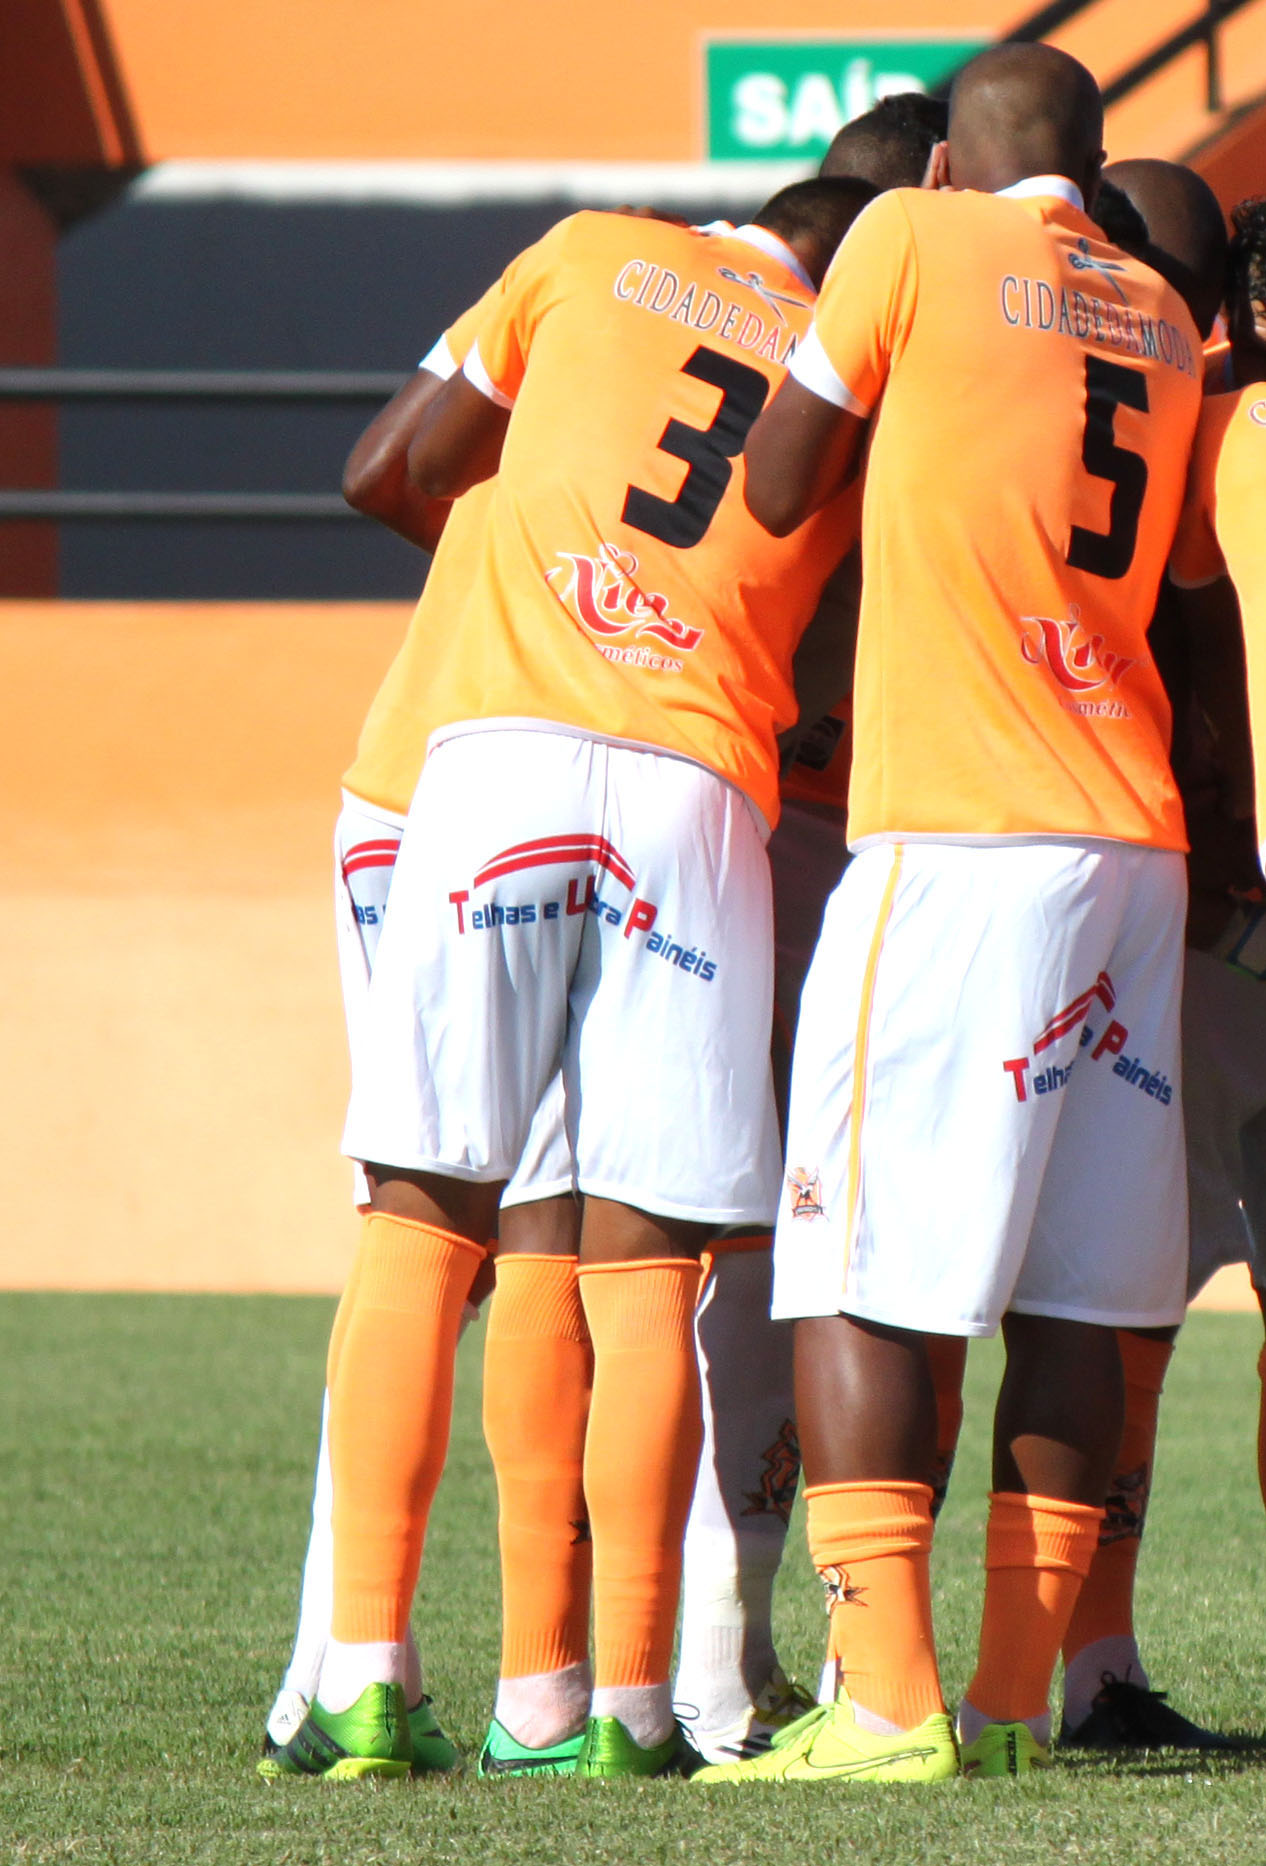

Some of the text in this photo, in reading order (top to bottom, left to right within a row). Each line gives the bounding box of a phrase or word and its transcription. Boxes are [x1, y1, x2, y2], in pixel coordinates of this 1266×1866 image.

[620, 344, 770, 549] 3
[1065, 354, 1149, 579] 5
[449, 889, 537, 935] Telhas
[543, 901, 560, 920] e
[624, 897, 718, 983] Painéis
[1090, 1019, 1173, 1107] Painéis
